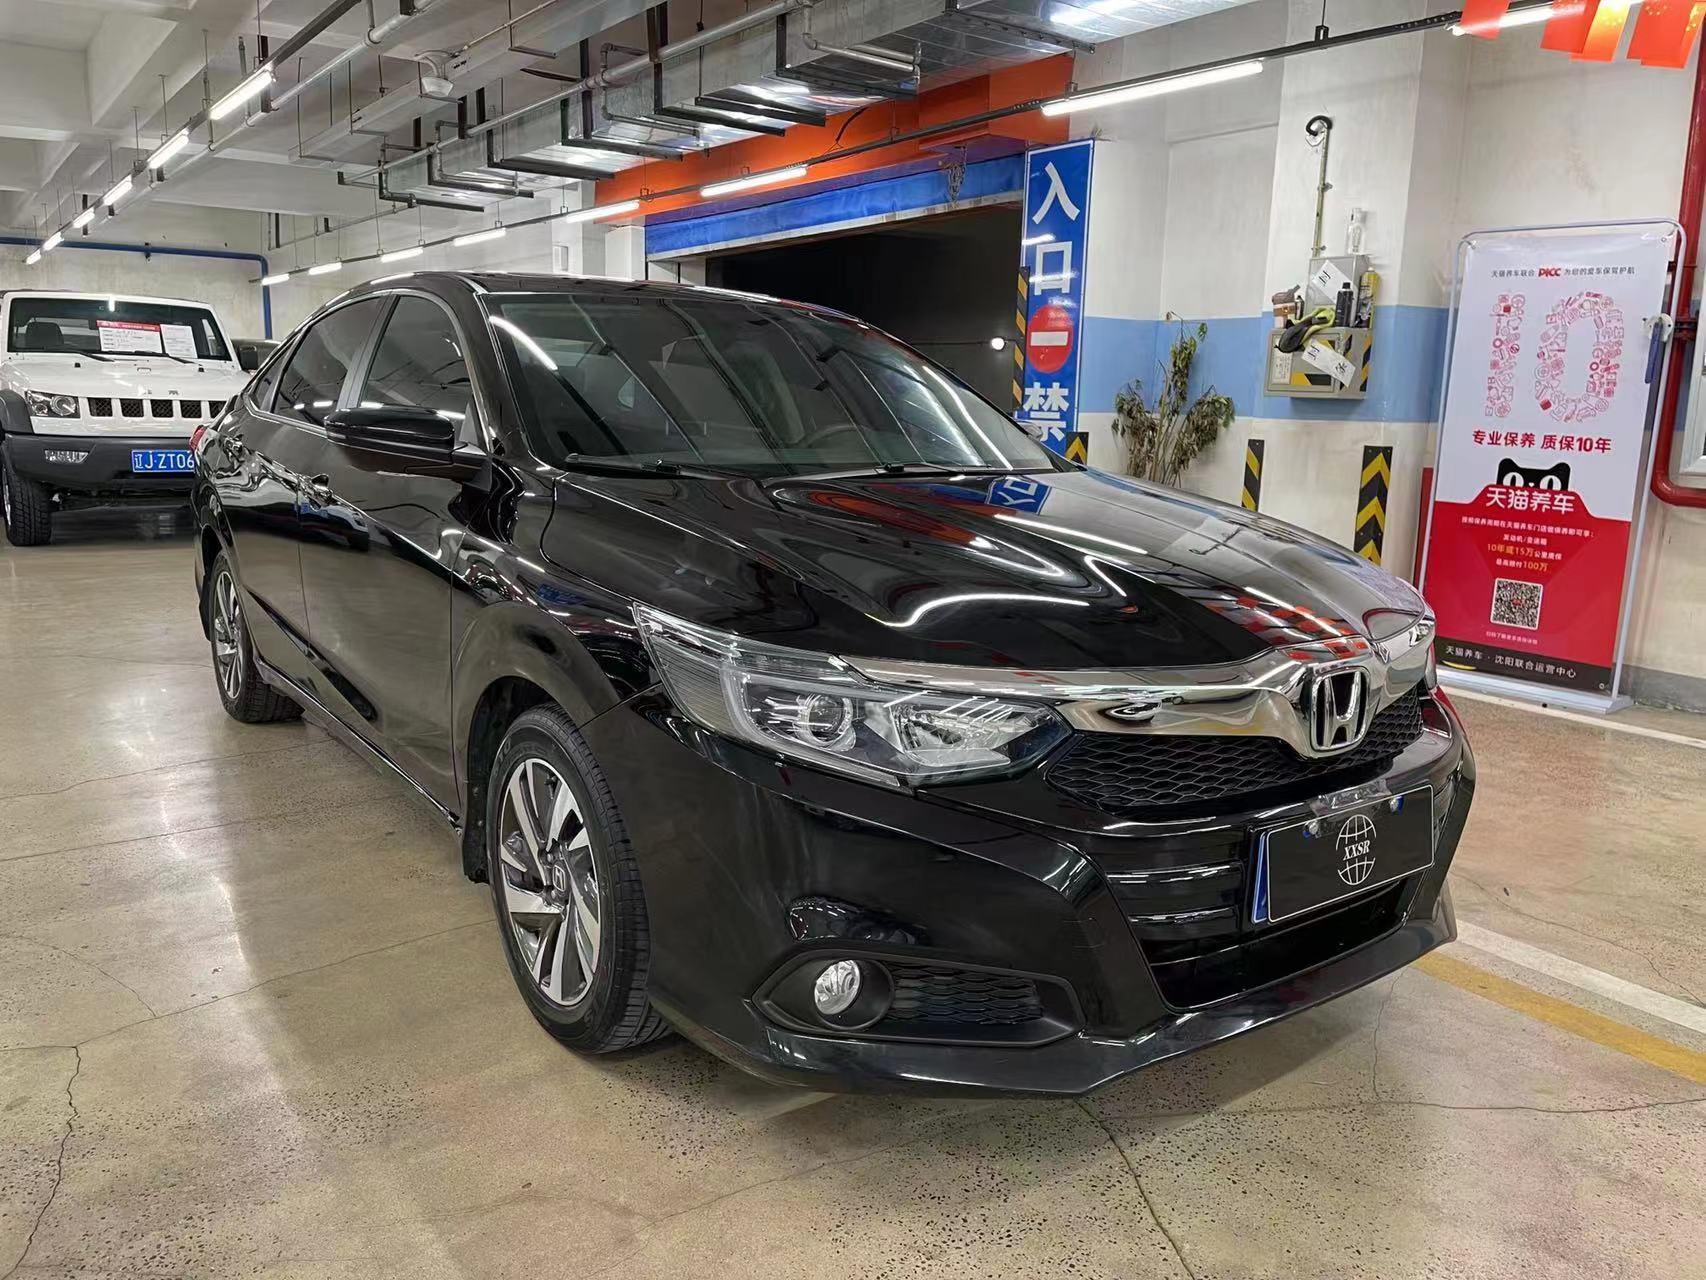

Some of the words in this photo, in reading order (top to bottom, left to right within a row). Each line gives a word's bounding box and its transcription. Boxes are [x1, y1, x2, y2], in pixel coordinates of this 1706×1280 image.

[1032, 161, 1080, 295] 入口
[1538, 267, 1562, 278] PICC
[1023, 382, 1069, 441] 禁
[1472, 430, 1535, 448] 专业保养
[1541, 434, 1612, 453] 质保10年
[1486, 487, 1575, 515] 天猫养车
[1445, 645, 1482, 660] 天猫养车
[1343, 840, 1370, 861] XXSR
